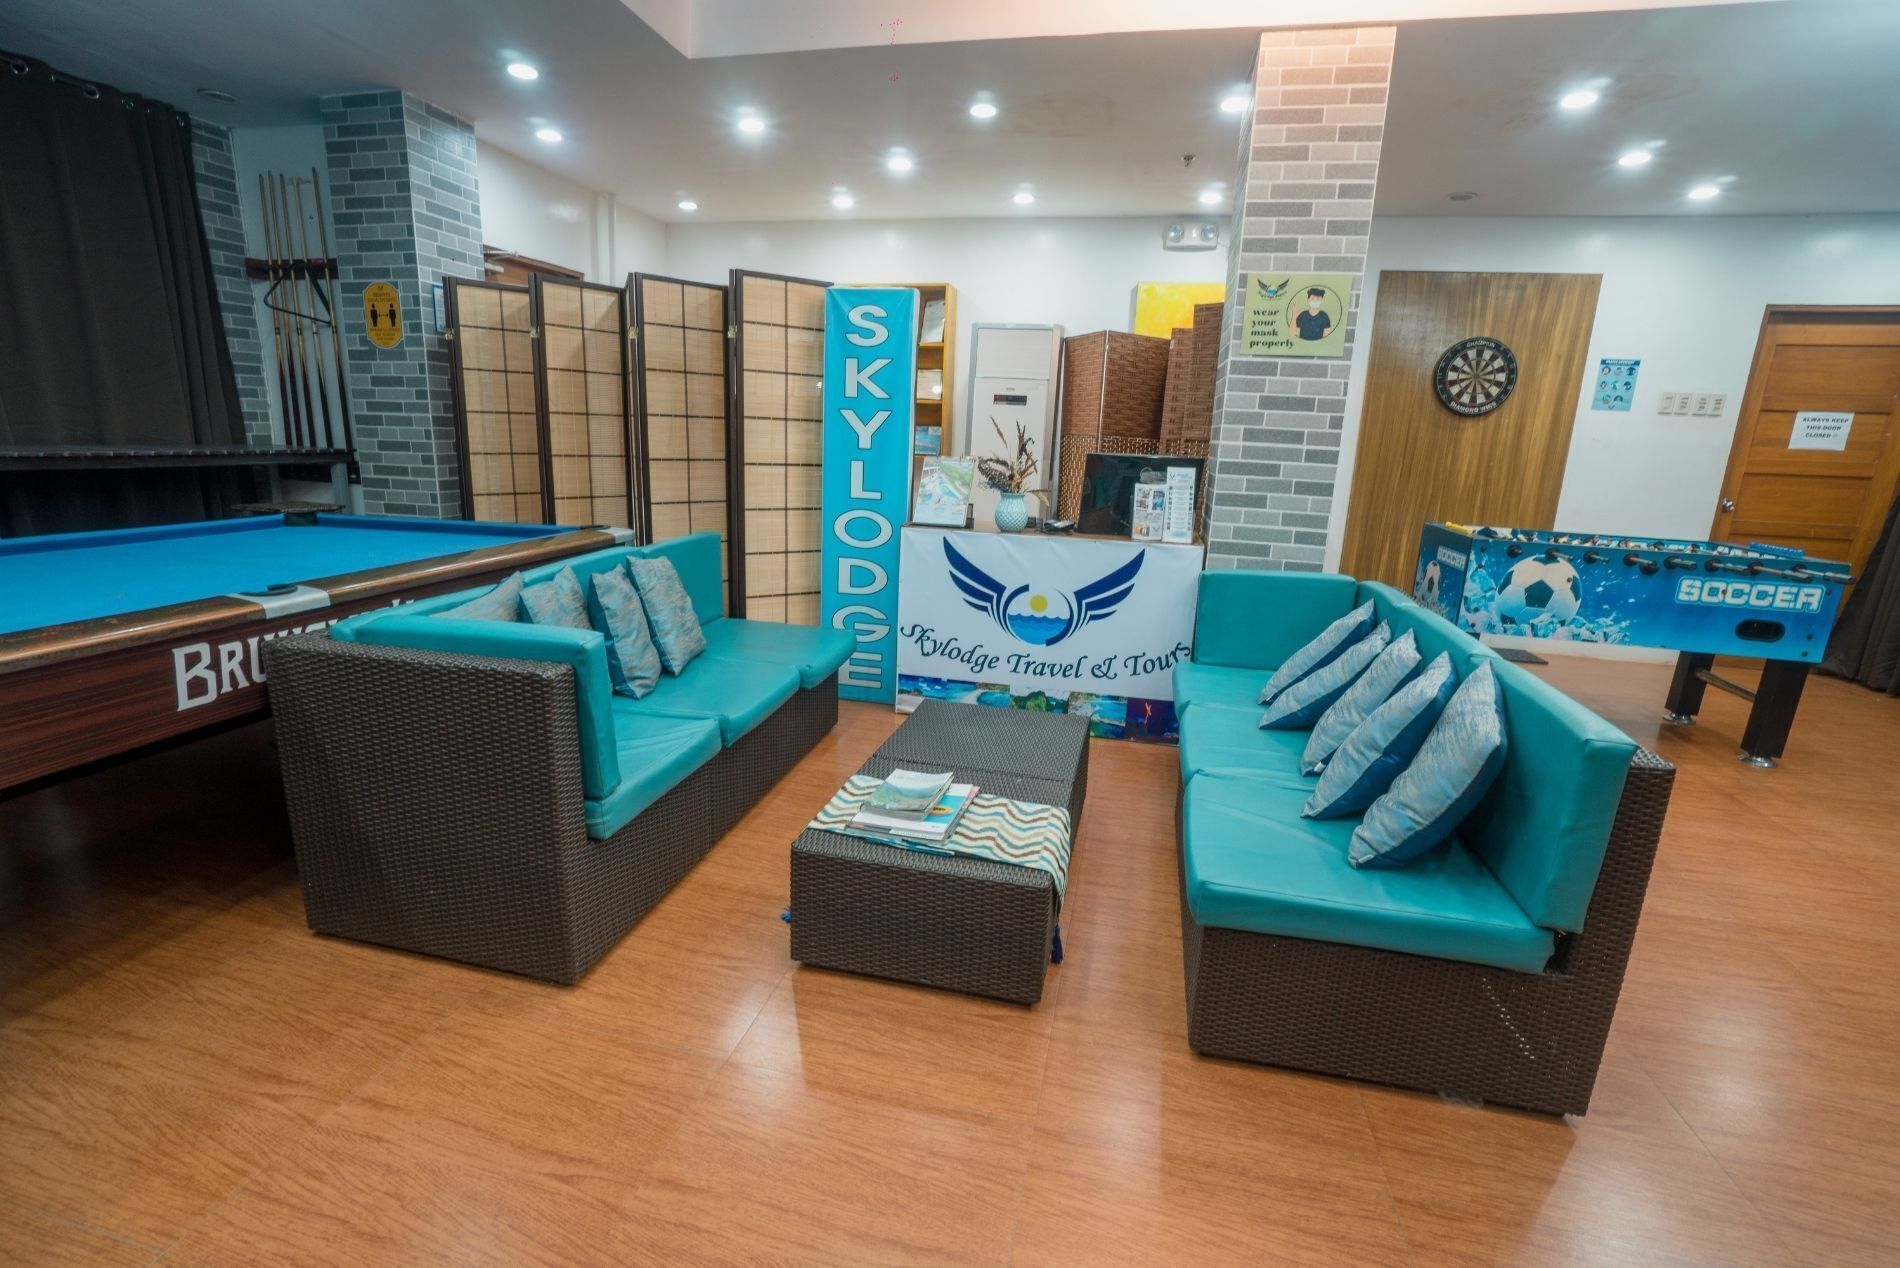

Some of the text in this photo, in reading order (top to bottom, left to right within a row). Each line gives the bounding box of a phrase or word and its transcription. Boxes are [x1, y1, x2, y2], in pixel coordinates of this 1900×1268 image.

[1250, 328, 1278, 337] mask
[1252, 320, 1276, 328] your
[1249, 338, 1293, 349] properly
[1436, 544, 1467, 571] SOCCER
[1677, 577, 1824, 612] SOCCER
[900, 623, 1192, 680] Skylodge Travel & Tours
